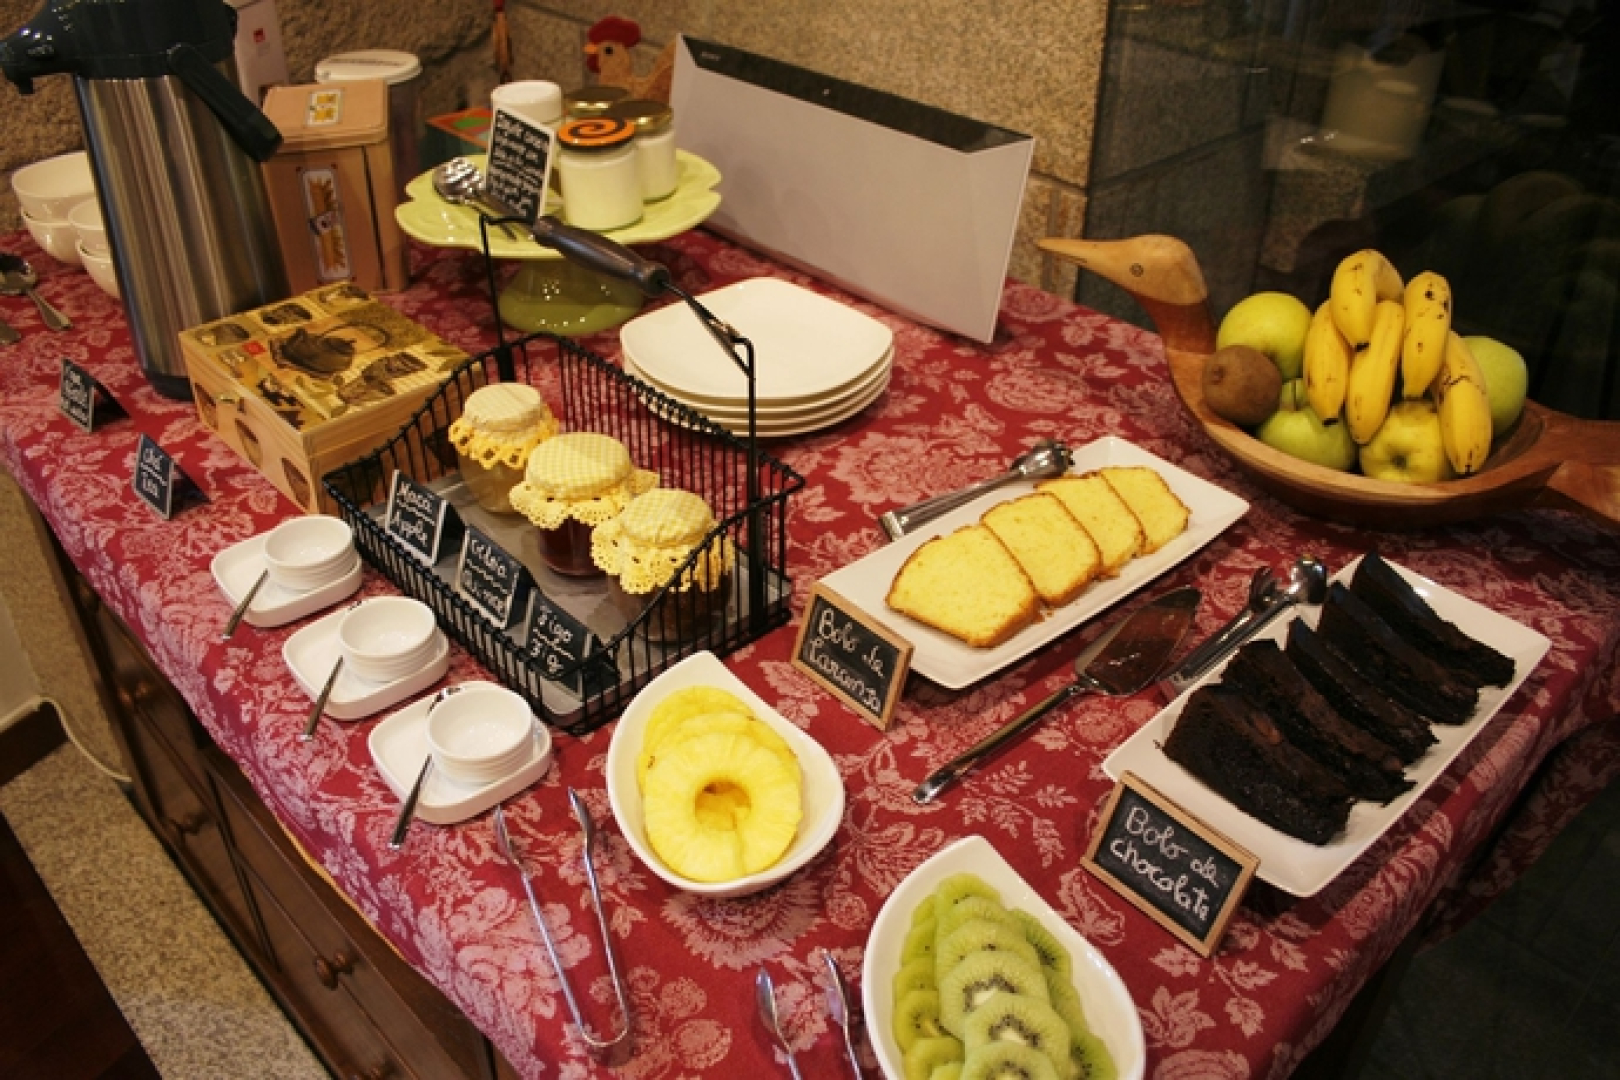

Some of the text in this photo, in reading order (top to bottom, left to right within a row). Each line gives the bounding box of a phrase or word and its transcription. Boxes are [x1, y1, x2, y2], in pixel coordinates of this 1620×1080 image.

[818, 607, 860, 653] Bolo
[1125, 806, 1219, 888] Bolo de
